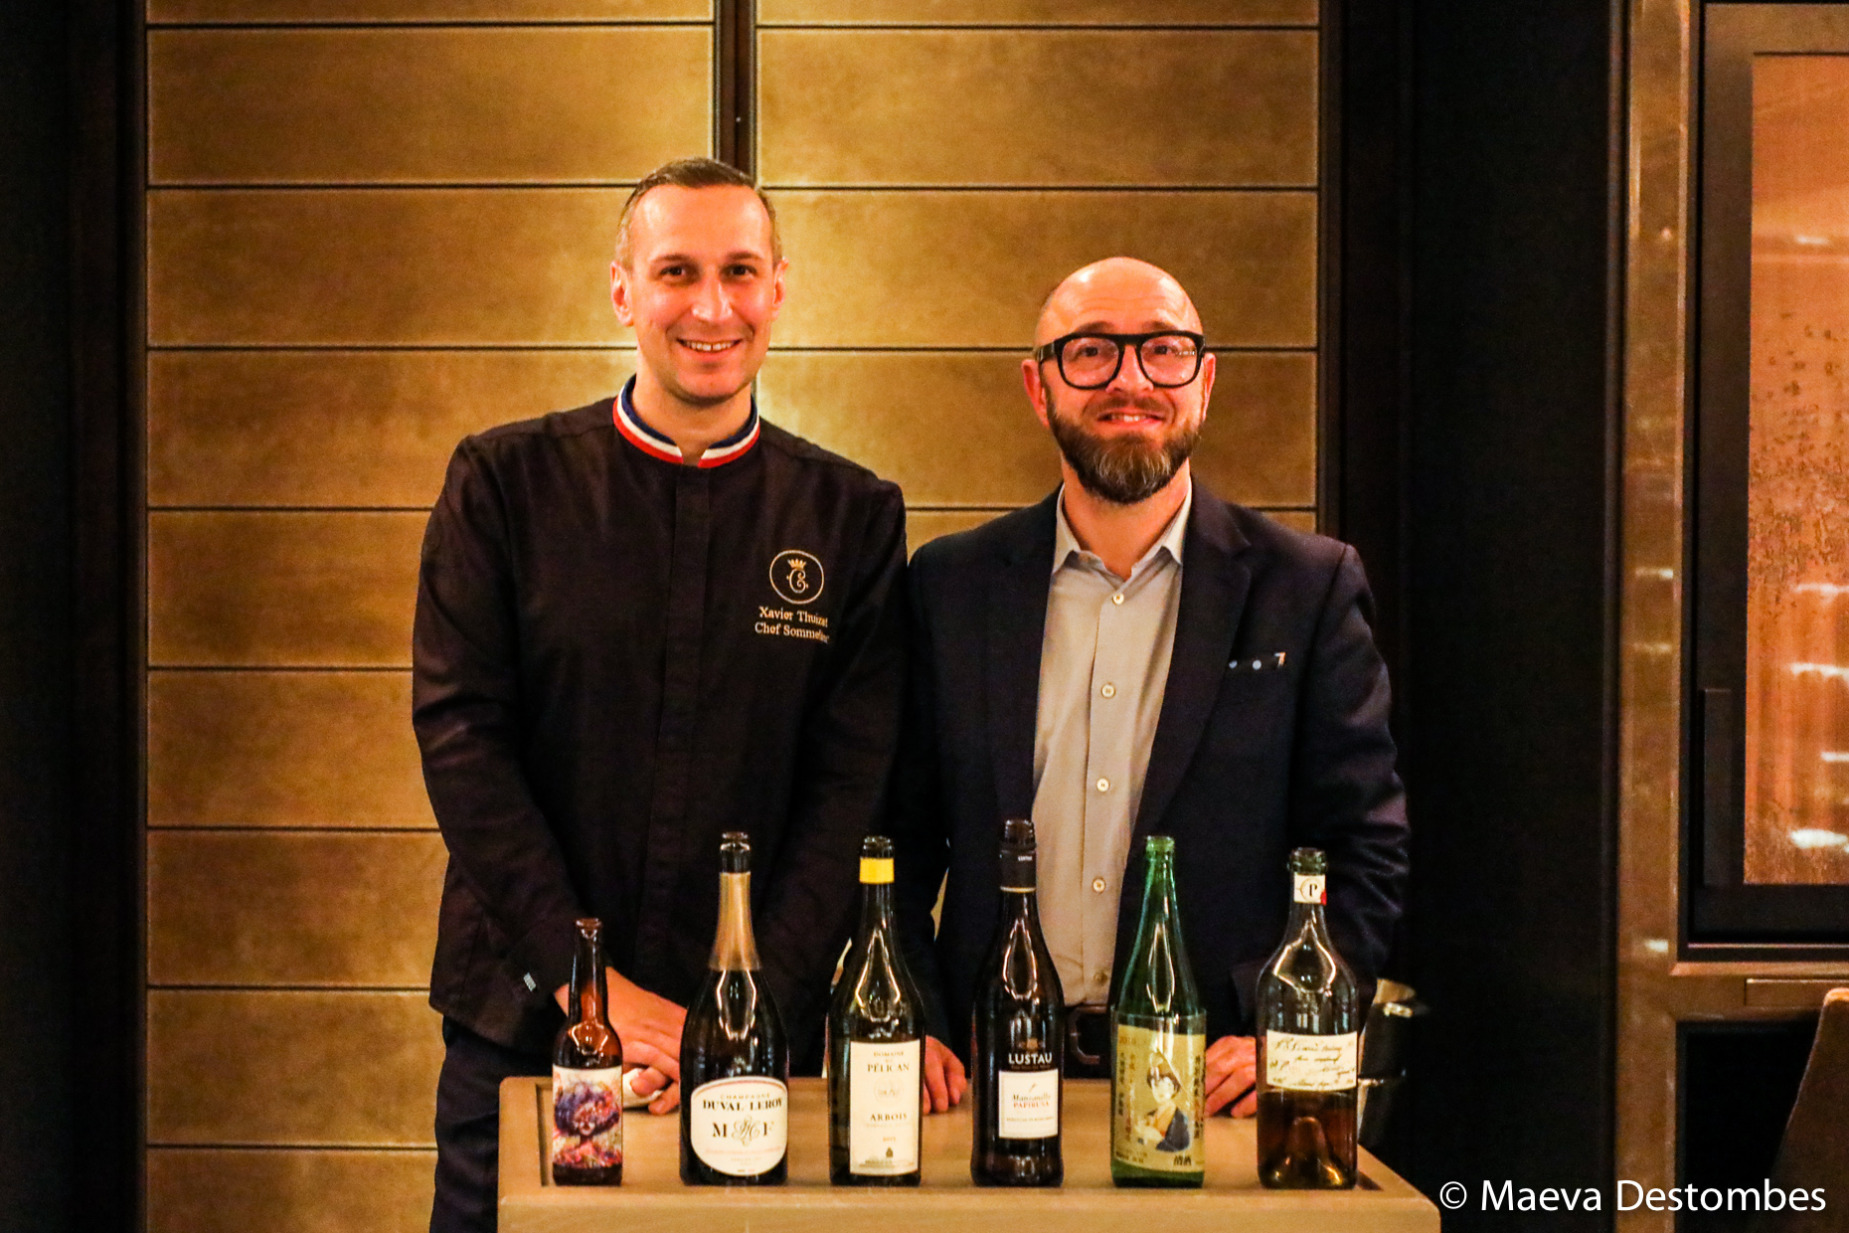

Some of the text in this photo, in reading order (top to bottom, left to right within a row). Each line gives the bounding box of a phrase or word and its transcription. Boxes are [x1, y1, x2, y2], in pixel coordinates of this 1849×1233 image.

[759, 605, 793, 621] Xavier
[754, 621, 781, 636] Chef
[1008, 1051, 1053, 1065] LUSTAU
[870, 1112, 907, 1121] ARBOIS
[712, 1122, 727, 1138] M
